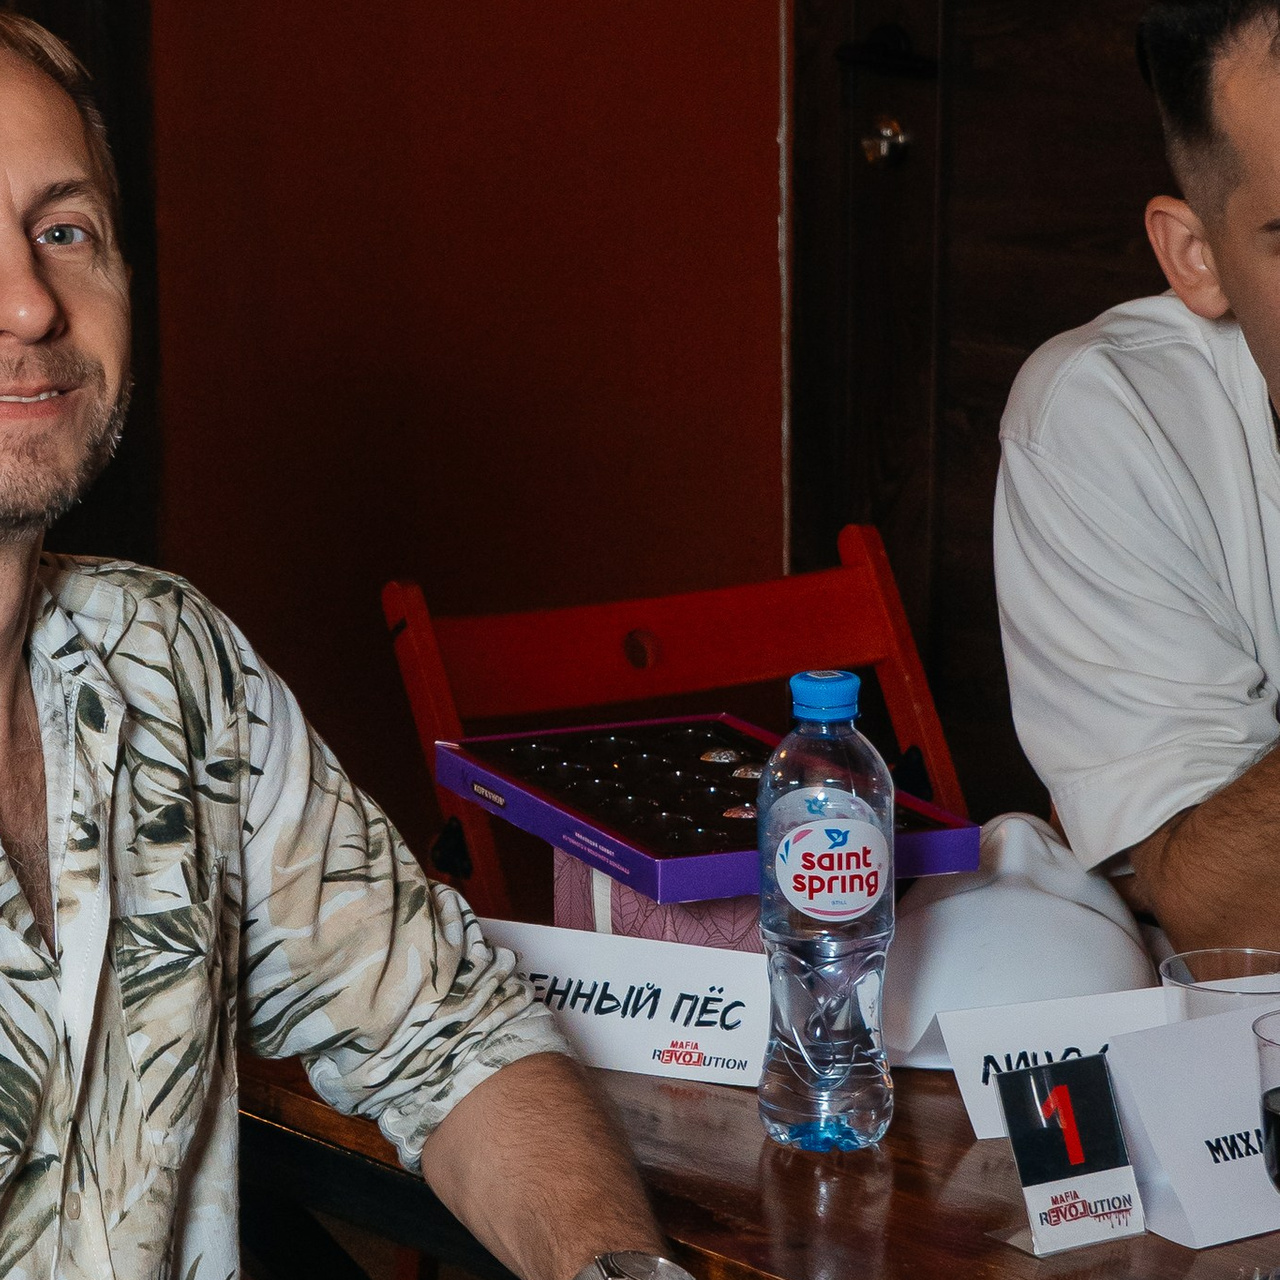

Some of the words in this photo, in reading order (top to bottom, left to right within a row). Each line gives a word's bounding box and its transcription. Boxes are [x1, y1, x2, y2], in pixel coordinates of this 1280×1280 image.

[801, 846, 872, 871] saint
[792, 870, 879, 901] spring
[528, 972, 662, 1020] ЕННЫЙ
[670, 985, 746, 1031] ПЁС
[670, 1040, 700, 1051] MAFIA
[1040, 1084, 1085, 1166] 1
[1050, 1190, 1080, 1205] MAFIA
